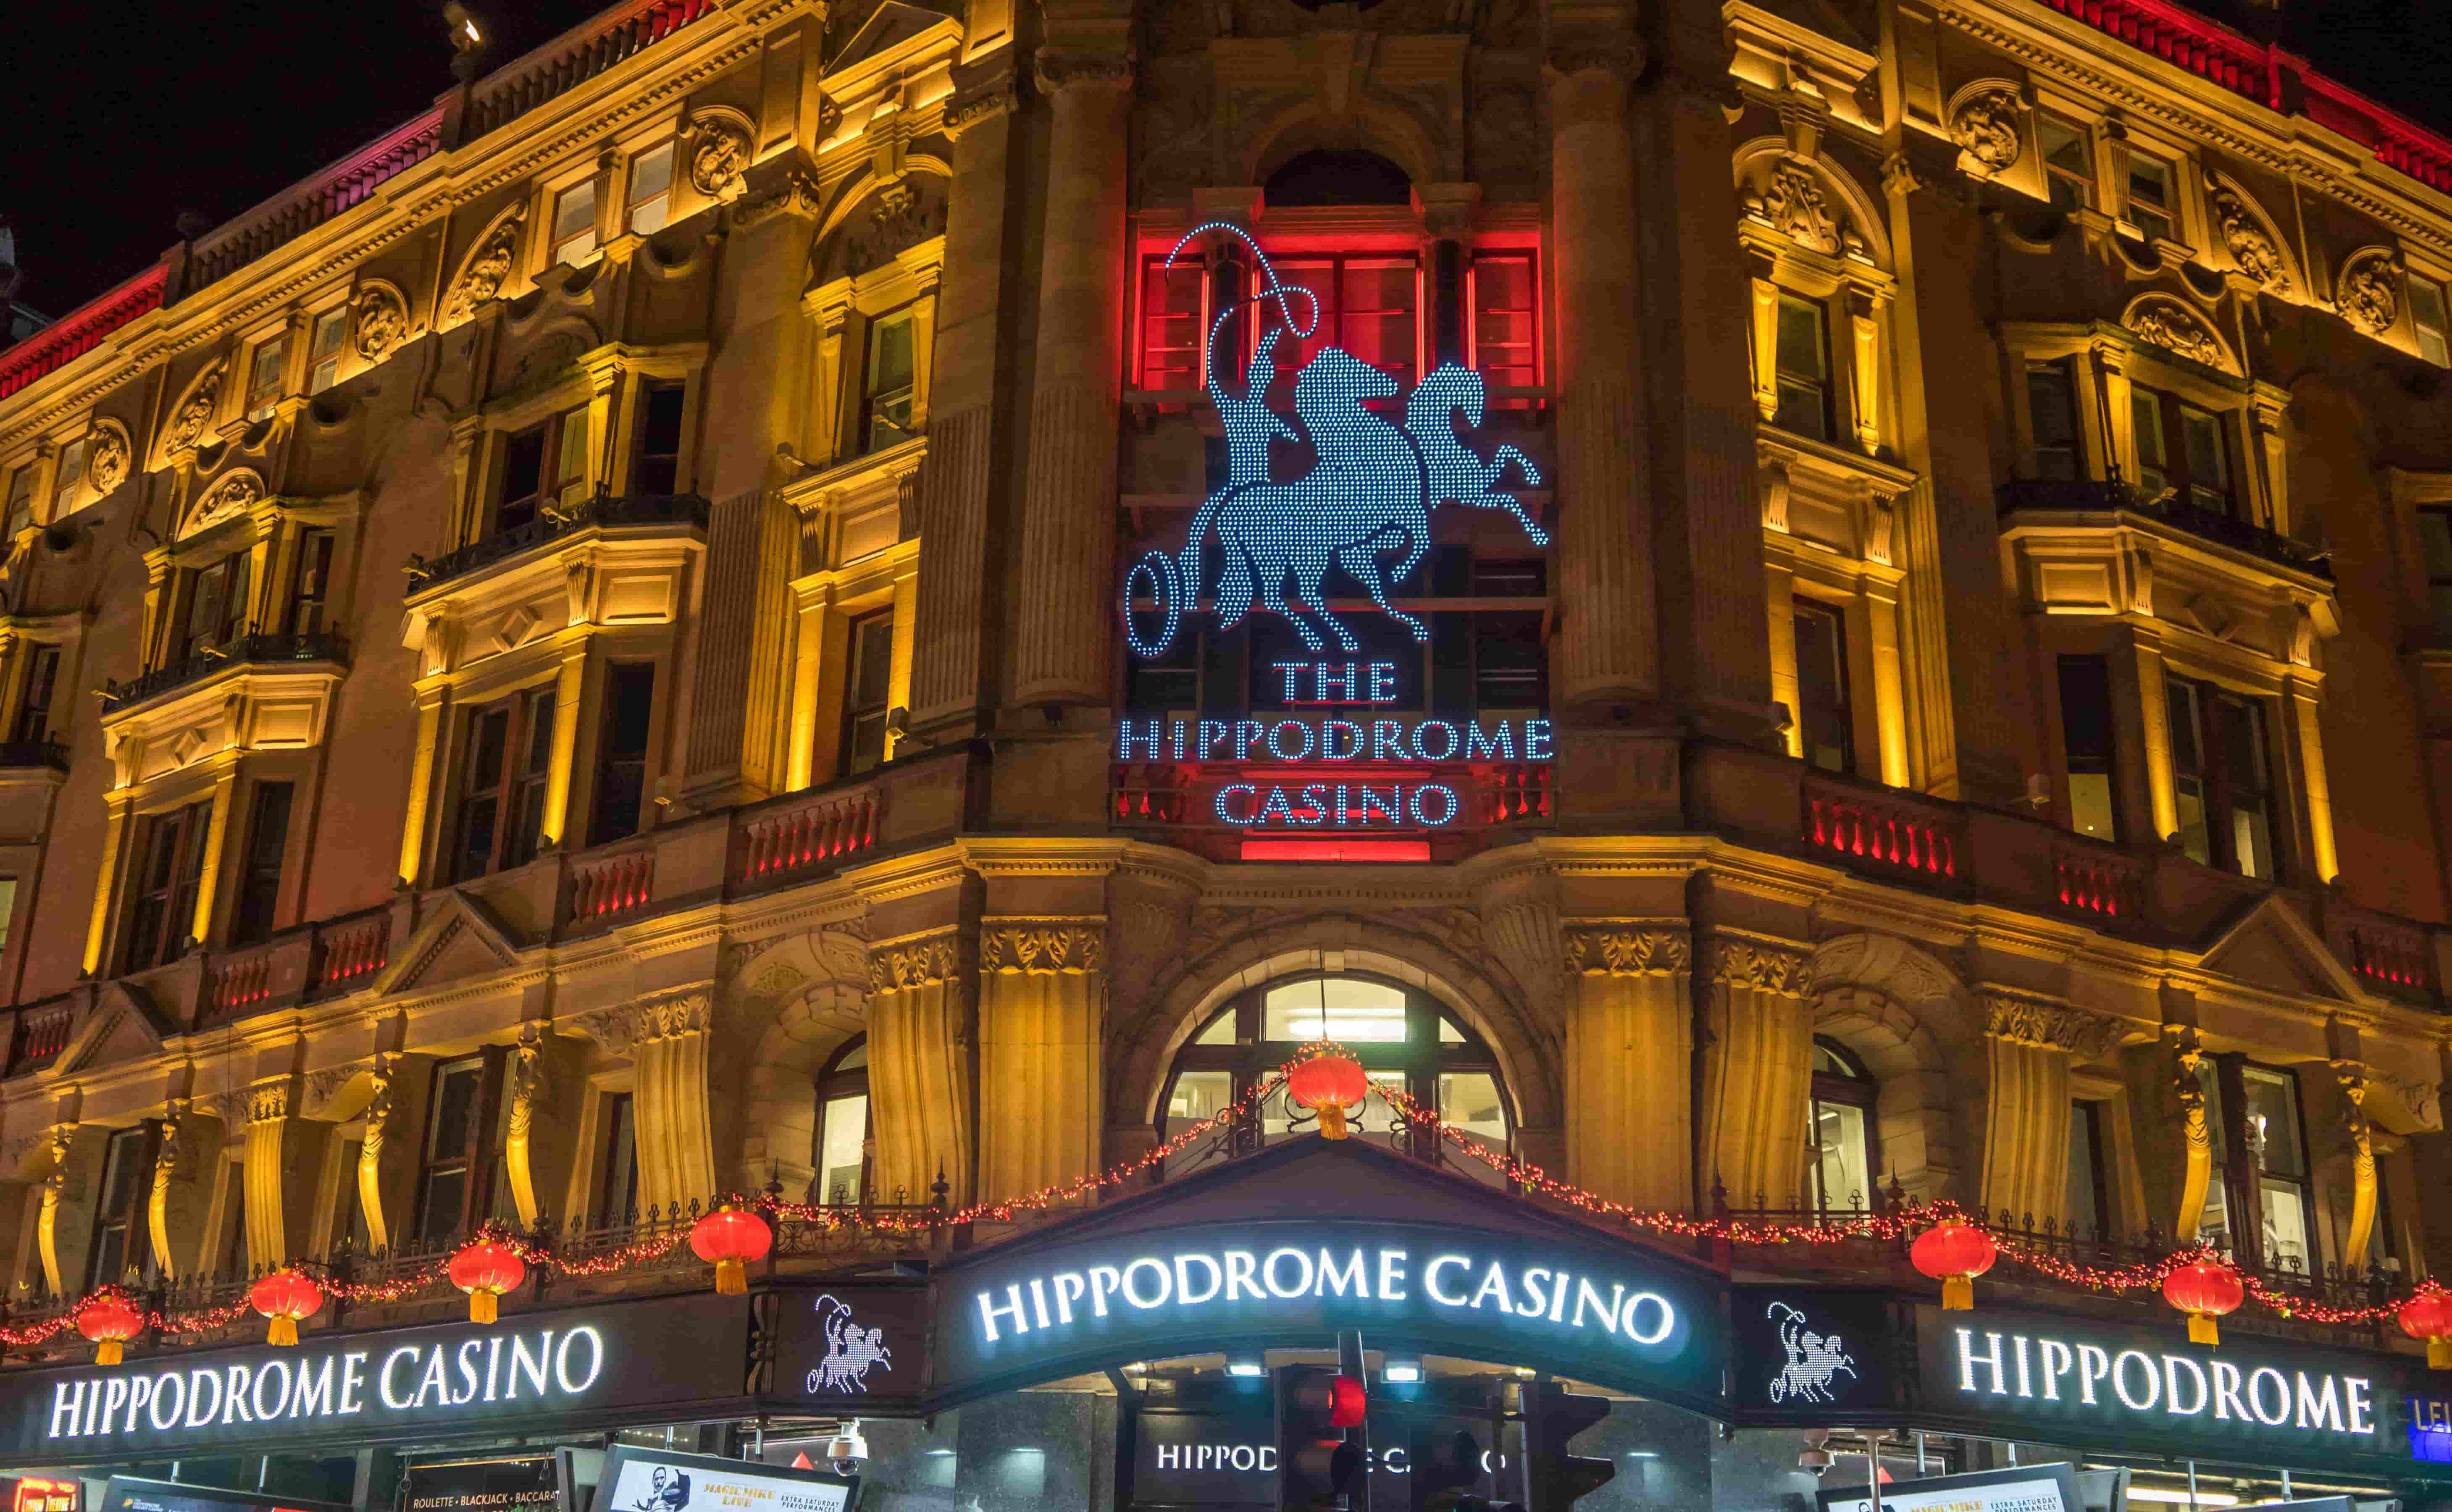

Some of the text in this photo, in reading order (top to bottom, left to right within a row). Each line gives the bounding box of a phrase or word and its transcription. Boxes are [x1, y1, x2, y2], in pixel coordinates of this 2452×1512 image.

[1273, 662, 1396, 701] THE
[1120, 719, 1553, 760] HIPPODROME
[1216, 784, 1458, 825] CASINO
[977, 1248, 1675, 1346] HIPPODROME CASINO
[49, 1326, 603, 1438] HIPPODROME CASINO
[1955, 1328, 2375, 1434] HIPPODROME
[413, 1490, 560, 1509] ROULETTE BLACKJACK BACCARAT
[781, 1495, 839, 1508] EXTRA SATURDAY
[782, 1502, 836, 1512] PERFORMANCES
[2017, 1496, 2057, 1506] SATURDAY
